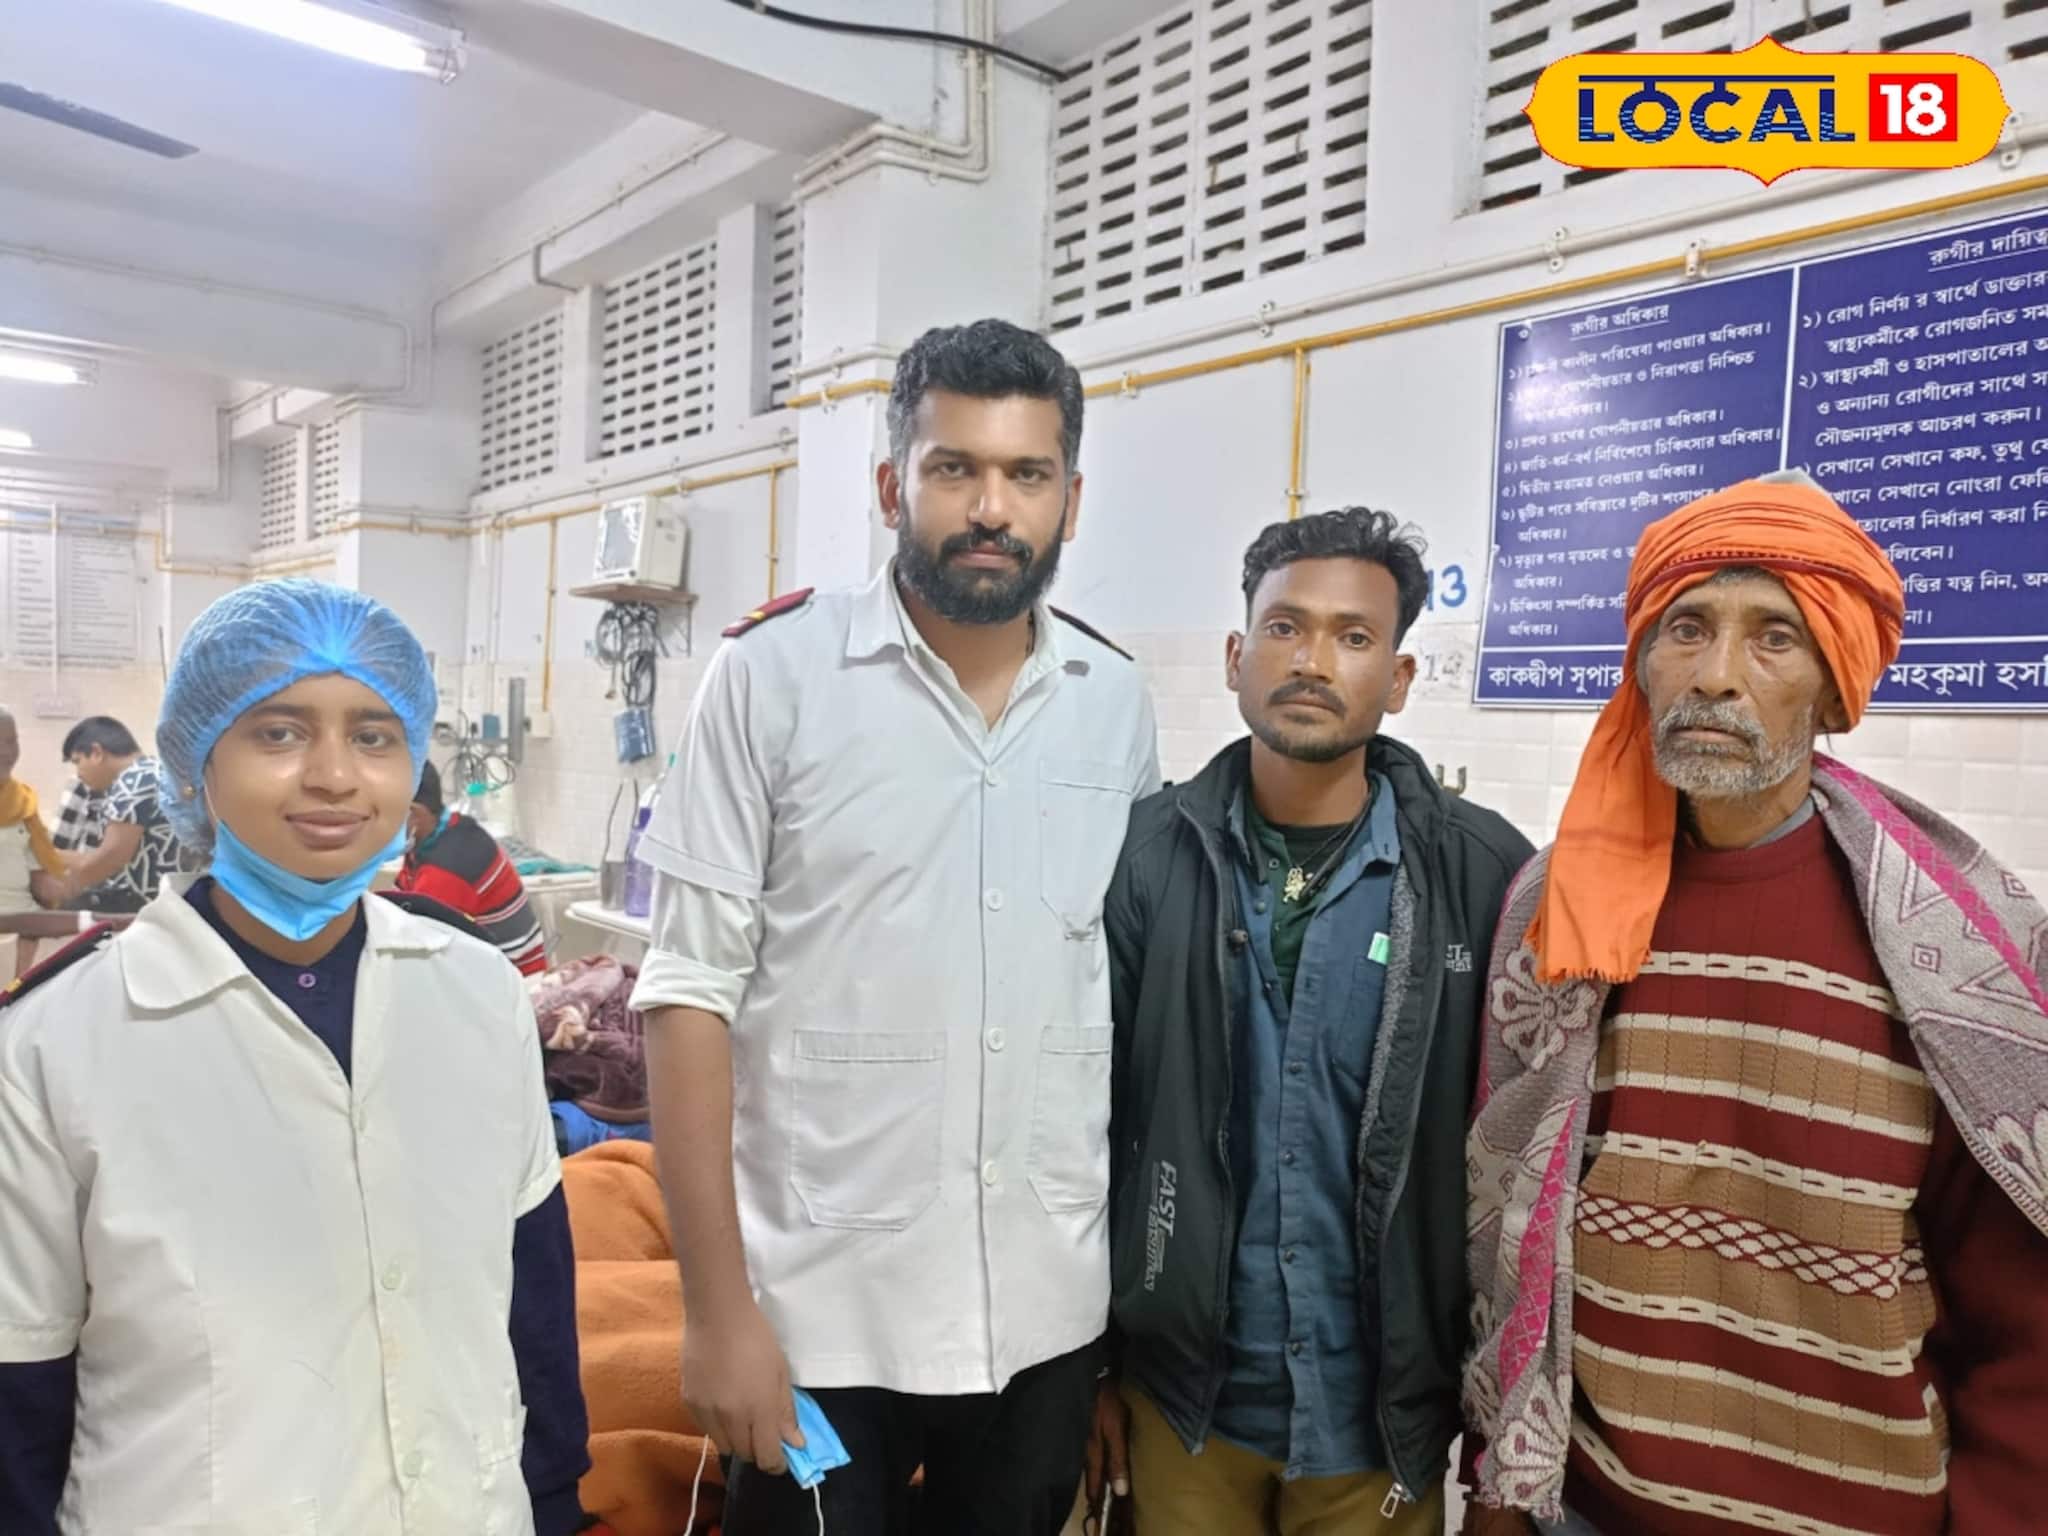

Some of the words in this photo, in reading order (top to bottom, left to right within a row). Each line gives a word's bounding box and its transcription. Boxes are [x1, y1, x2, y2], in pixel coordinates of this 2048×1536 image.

[1612, 304, 1669, 326] অধিকার
[1802, 311, 1822, 329] ১)
[1827, 303, 1864, 325] রোগ
[1924, 307, 2018, 339] রোগজনিত
[1798, 371, 1817, 390] ২)
[1895, 359, 1909, 373] ও
[1914, 340, 2029, 373] হাসপাতালের
[1816, 402, 1830, 415] ও
[1835, 393, 1890, 412] অন্যান্য
[1896, 381, 1975, 406] রোগীদের
[1980, 373, 2027, 393] সাথে
[1918, 413, 1977, 433] আচরণ
[1881, 449, 1943, 471] সেখানে
[1877, 481, 1940, 503] সেখানে
[1946, 475, 2002, 496] নোংরা
[1921, 508, 1984, 530] নির্ধারণ
[1988, 506, 2026, 524] করা
[1945, 575, 1974, 592] যত্ন
[1488, 658, 1565, 688] কাকদ্বীপ
[1569, 663, 1624, 695] সুপার
[1887, 660, 1987, 696] মহকুমা
[1158, 1160, 1177, 1237] FAST
